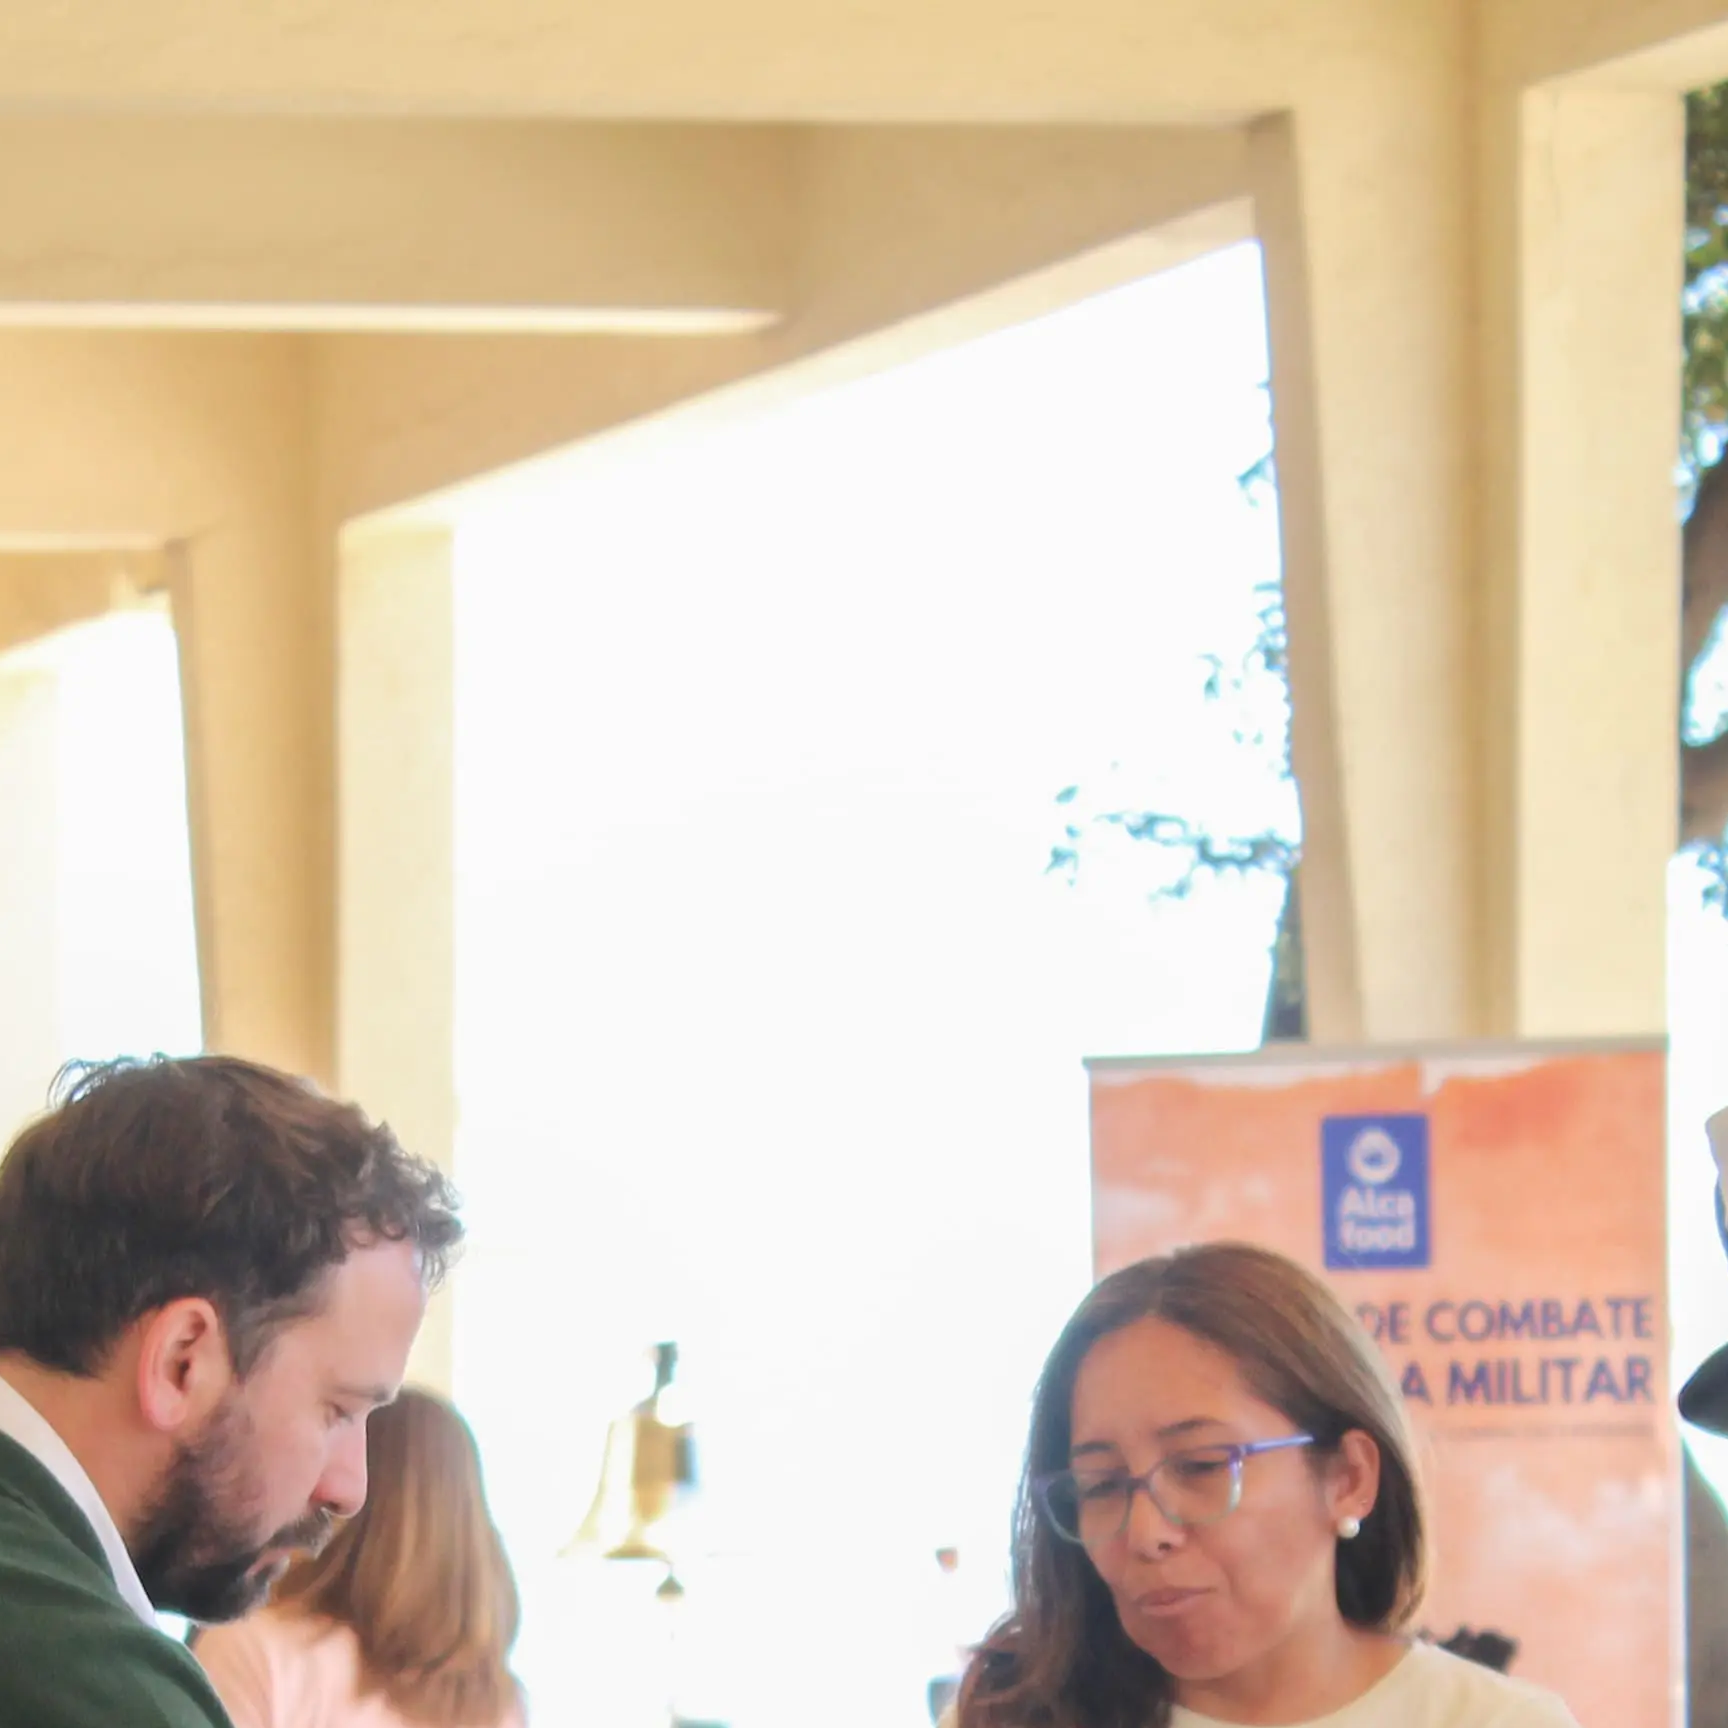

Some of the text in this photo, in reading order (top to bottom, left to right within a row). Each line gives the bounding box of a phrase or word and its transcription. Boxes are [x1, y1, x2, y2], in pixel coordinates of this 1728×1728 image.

[1339, 1220, 1416, 1252] food
[1425, 1296, 1654, 1342] COMBATE
[1446, 1354, 1656, 1405] MILITAR
